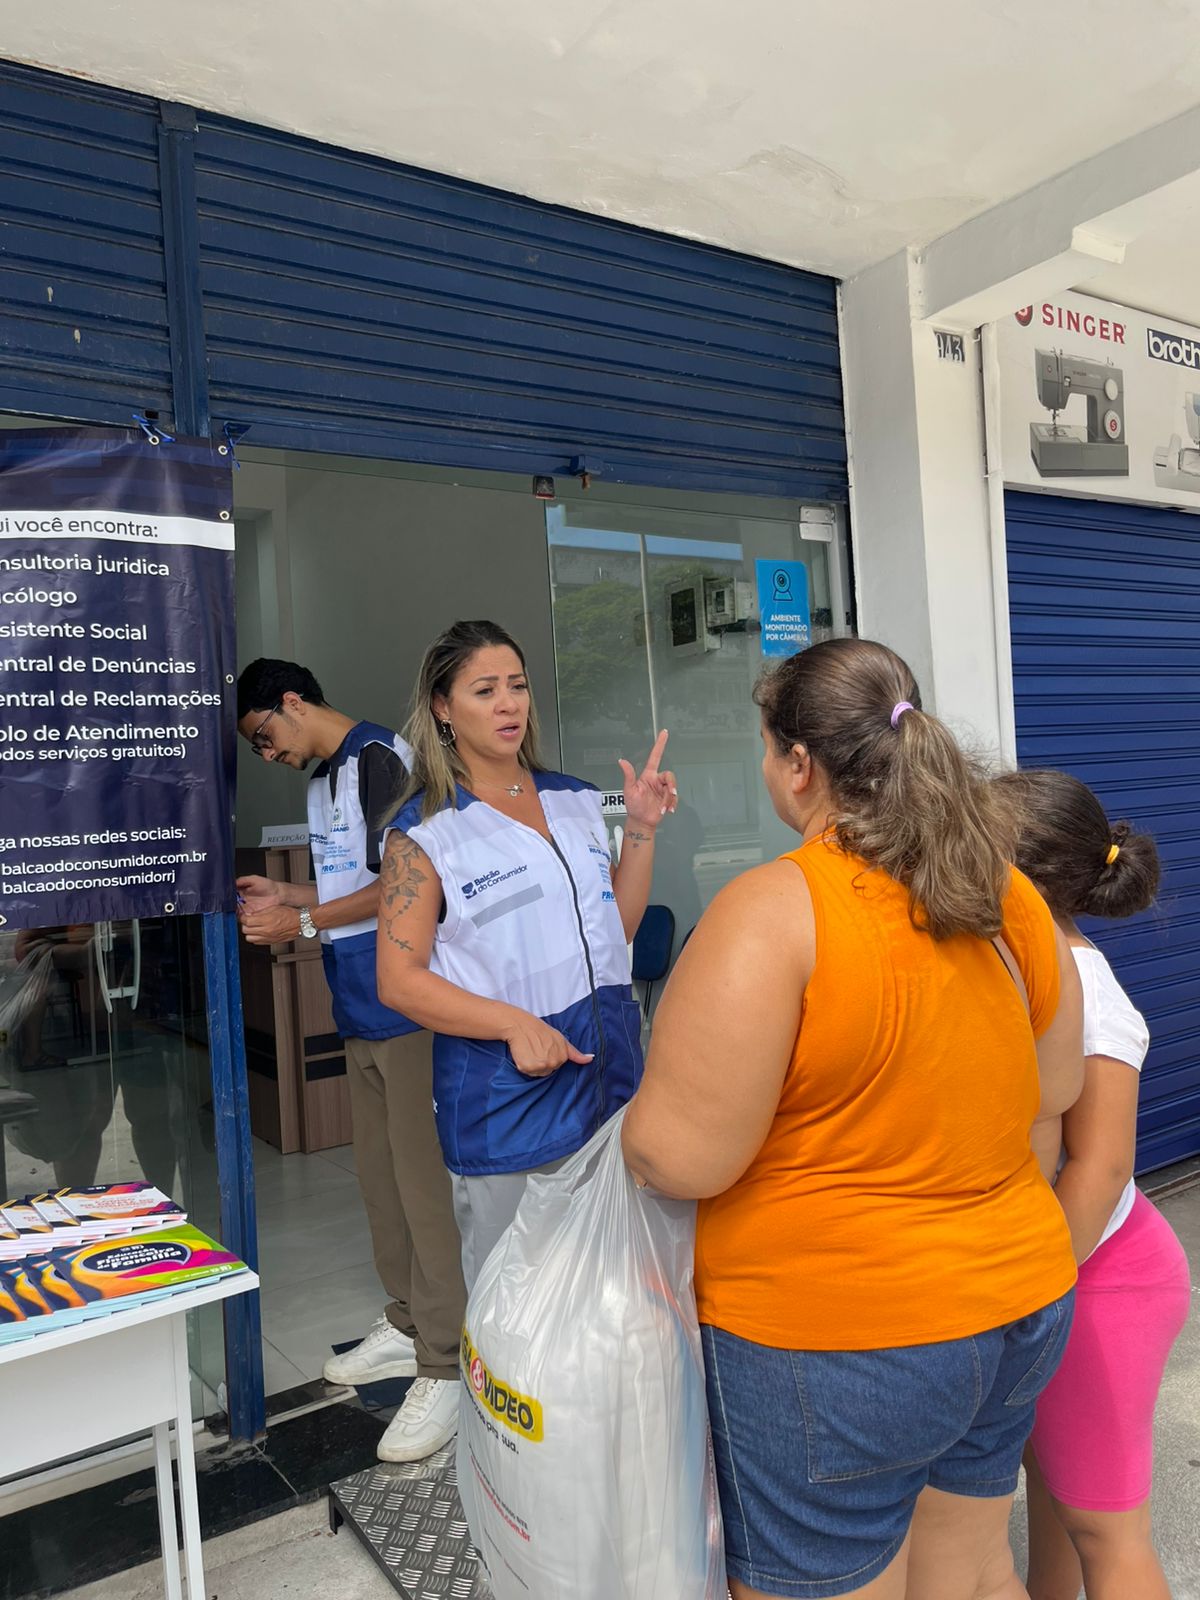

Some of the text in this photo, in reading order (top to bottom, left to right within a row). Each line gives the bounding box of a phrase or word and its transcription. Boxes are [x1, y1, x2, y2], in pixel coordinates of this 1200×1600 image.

[1042, 303, 1125, 344] SINGER
[15, 517, 63, 532] você
[68, 519, 158, 537] encontra:
[96, 554, 170, 576] juridica
[765, 624, 807, 632] MONITORADO
[770, 614, 801, 622] AMBIENTE
[0, 621, 147, 640] sistente Social
[0, 655, 196, 673] ntral de Denúncias
[61, 690, 87, 706] de
[94, 690, 221, 710] Reclamações
[33, 725, 60, 741] de
[65, 723, 199, 740] Atendimento
[0, 743, 186, 761] dos serviços gratuitos)
[20, 835, 80, 848] nossas
[84, 829, 128, 845] redes
[130, 826, 187, 840] sociais:
[267, 833, 306, 843] RECEPÇÃO
[1, 851, 207, 875] balcaodoconsumidor.com.br
[2, 870, 176, 894] balcaodoconosumidorrj
[474, 870, 500, 886] Balcão
[478, 865, 528, 892] do Consumidor
[483, 1369, 534, 1430] VIDEO
